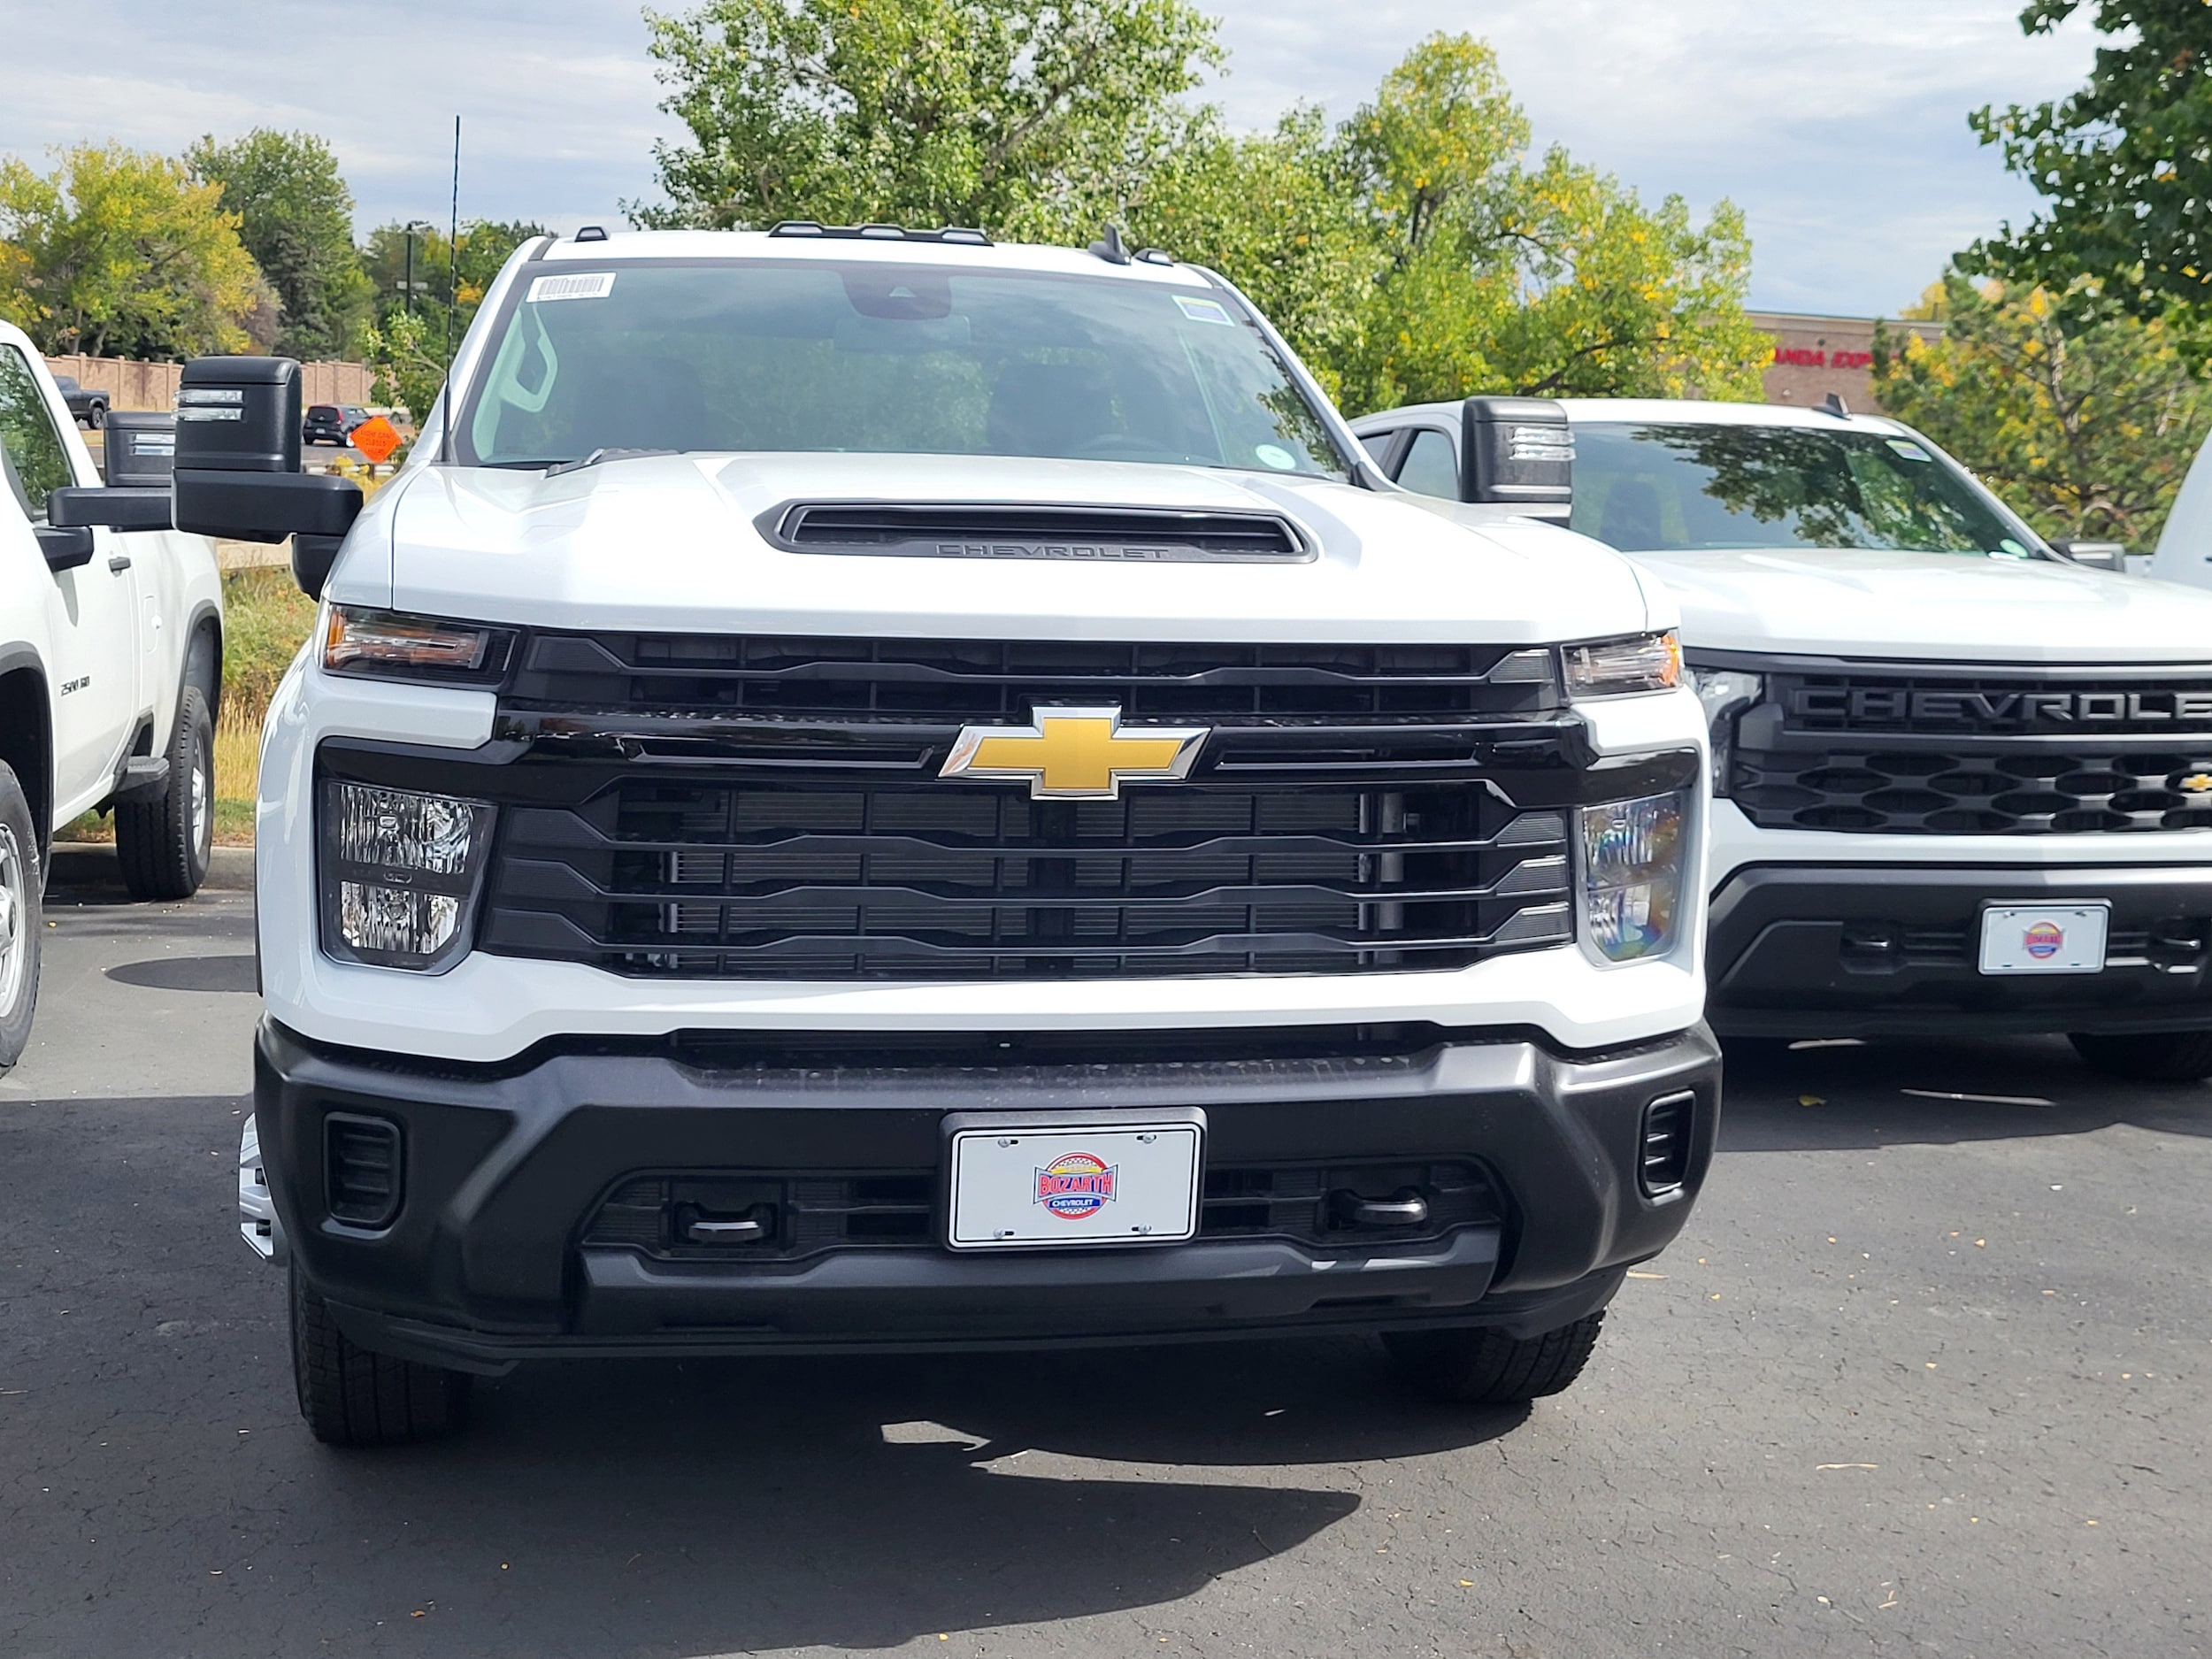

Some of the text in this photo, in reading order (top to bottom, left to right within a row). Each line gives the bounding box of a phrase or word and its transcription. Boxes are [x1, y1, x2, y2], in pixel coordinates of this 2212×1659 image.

[1775, 348, 1825, 367] ANDA
[934, 543, 1170, 559] CHEVROLET
[1790, 687, 2212, 722] CHEVROLE
[1038, 1172, 1113, 1196] BOZARTH
